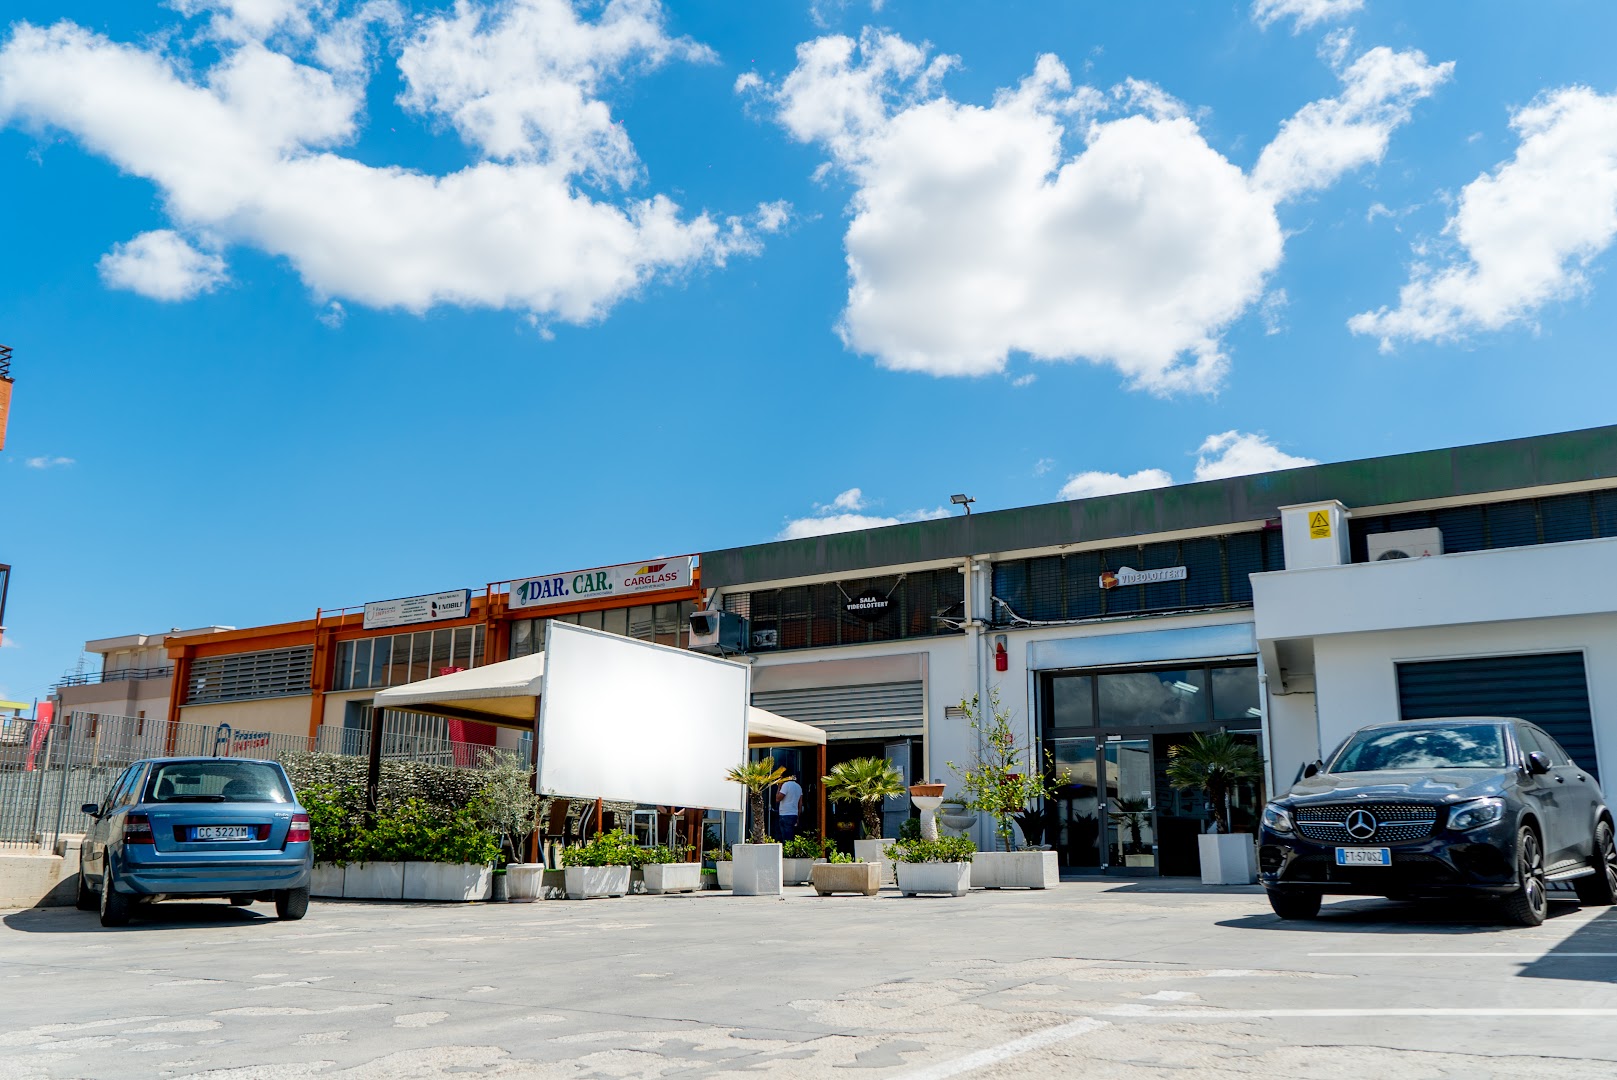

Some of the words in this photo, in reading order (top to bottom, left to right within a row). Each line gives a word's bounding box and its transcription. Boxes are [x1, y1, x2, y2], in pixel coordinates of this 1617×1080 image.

[624, 572, 677, 587] CARGLASS
[1121, 568, 1184, 584] VIDEOLOTTERY
[529, 577, 569, 600] DAR.
[572, 571, 613, 594] CAR.
[847, 601, 888, 610] VIDEOLOTTERY
[215, 827, 247, 837] 322YM
